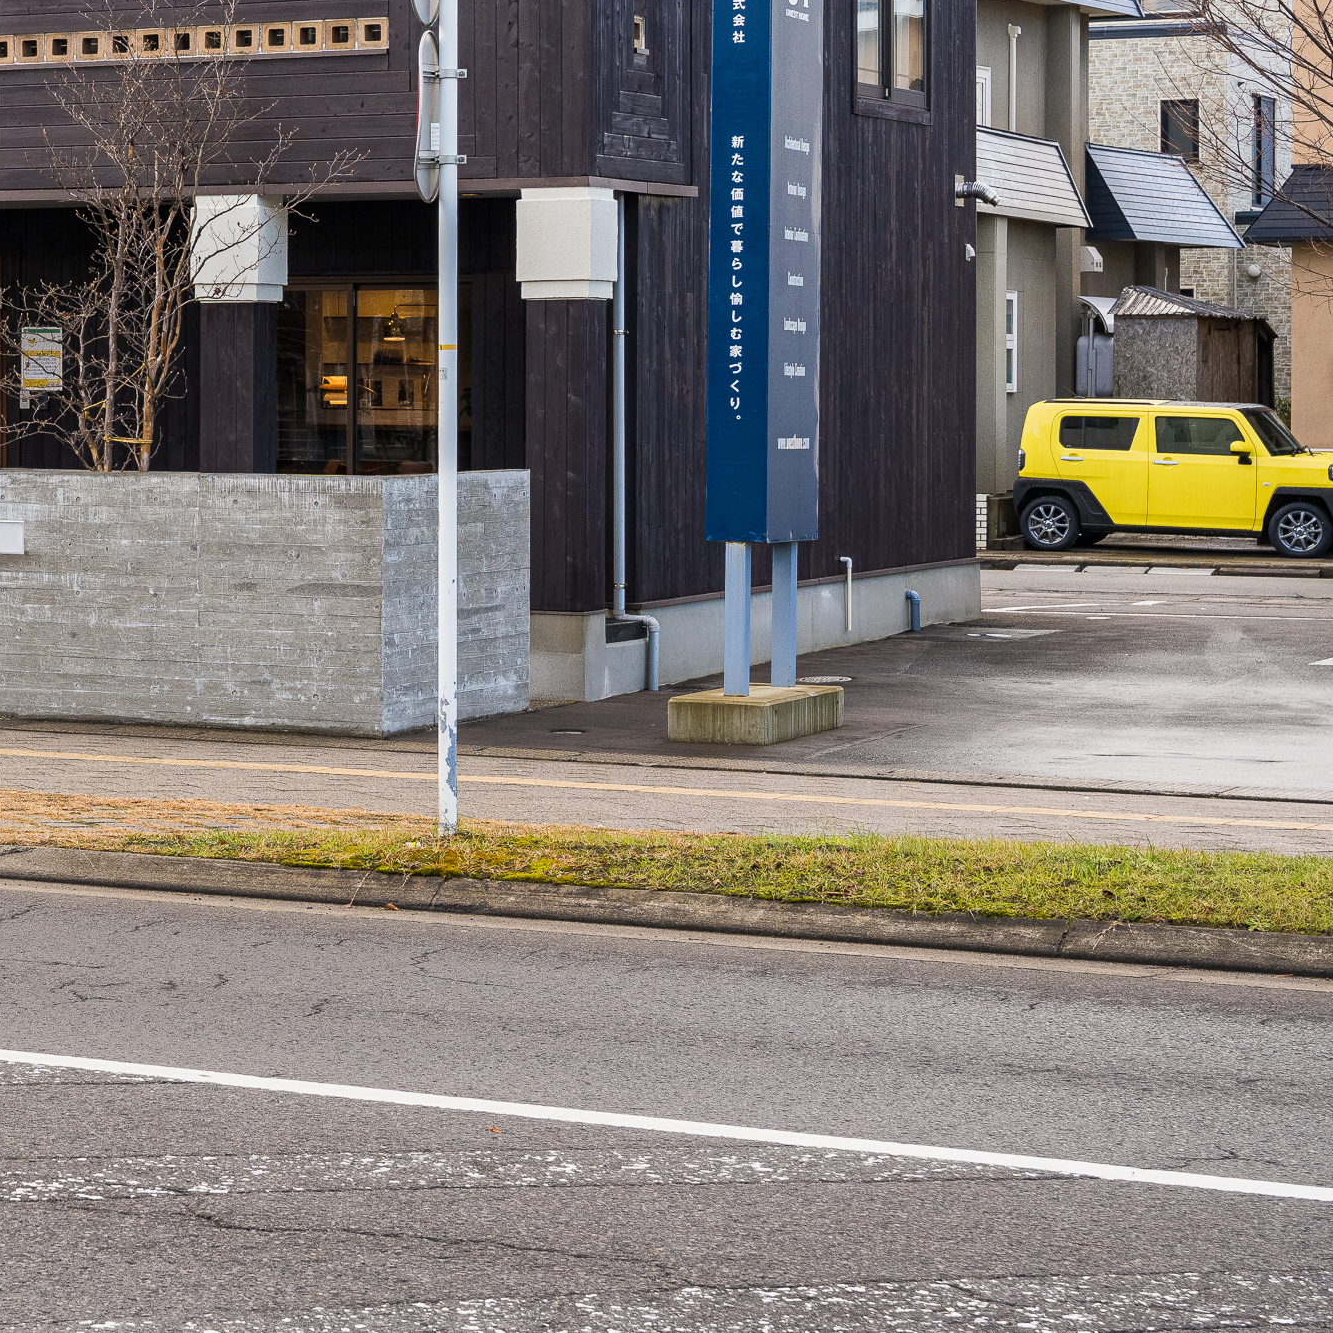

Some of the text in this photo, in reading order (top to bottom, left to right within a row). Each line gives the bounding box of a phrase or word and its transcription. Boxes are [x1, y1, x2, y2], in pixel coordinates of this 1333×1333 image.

[729, 134, 744, 420] 新たな価値で暮らし愉しむ家づくり。
